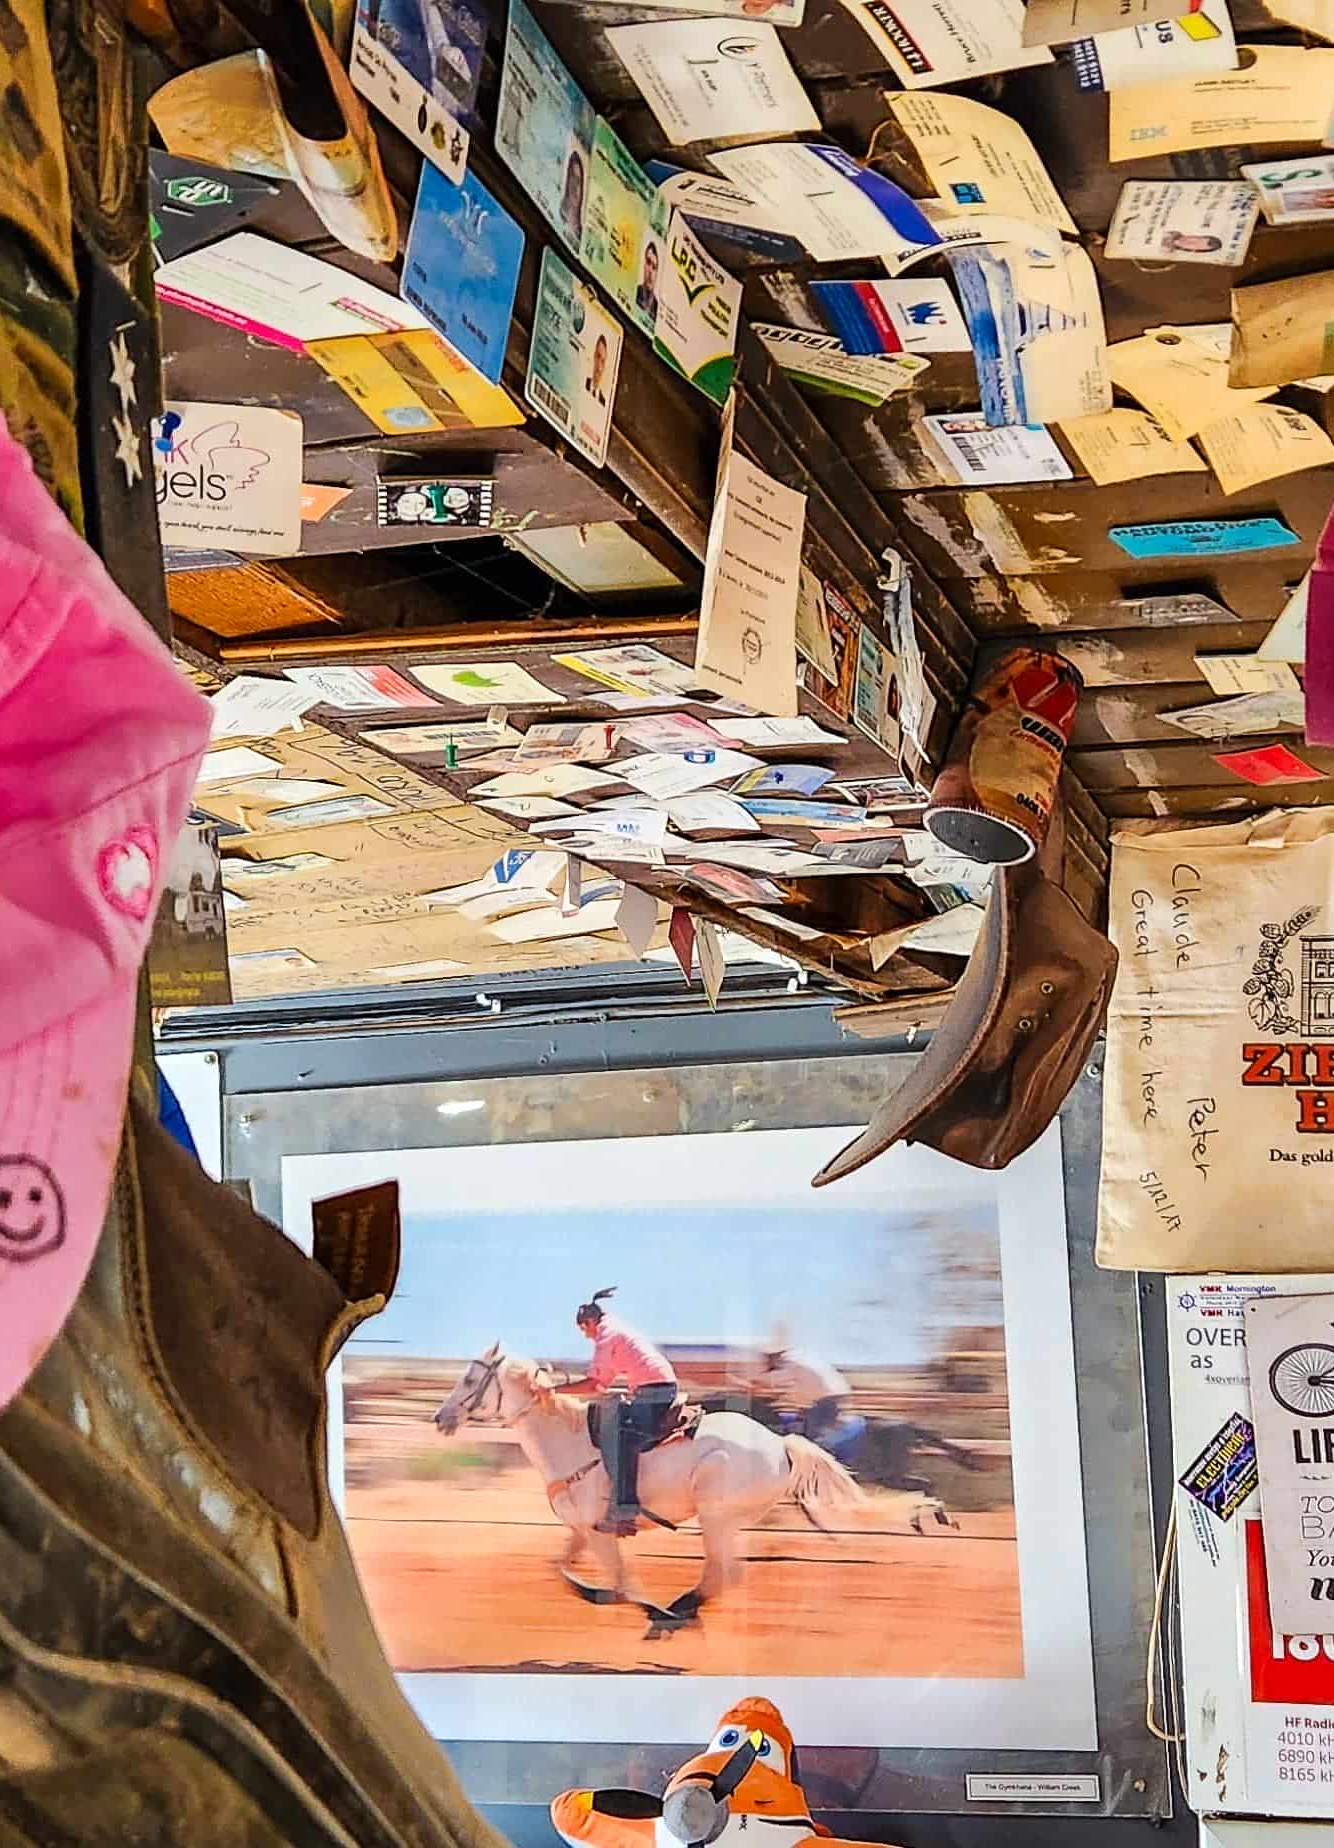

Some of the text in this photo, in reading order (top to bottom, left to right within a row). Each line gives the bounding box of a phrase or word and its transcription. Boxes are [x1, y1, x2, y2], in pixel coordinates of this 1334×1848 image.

[1170, 862, 1204, 969] Claude
[1130, 887, 1167, 1129] Great time here
[1185, 1095, 1223, 1185] Peter
[1268, 1147, 1298, 1166] Das
[1226, 1284, 1277, 1296] Mornington
[1190, 1352, 1214, 1369] as
[1284, 1716, 1302, 1729] HF
[1276, 1731, 1315, 1747] 4010
[1277, 1749, 1316, 1765] 6890
[1278, 1767, 1317, 1783] 8165
